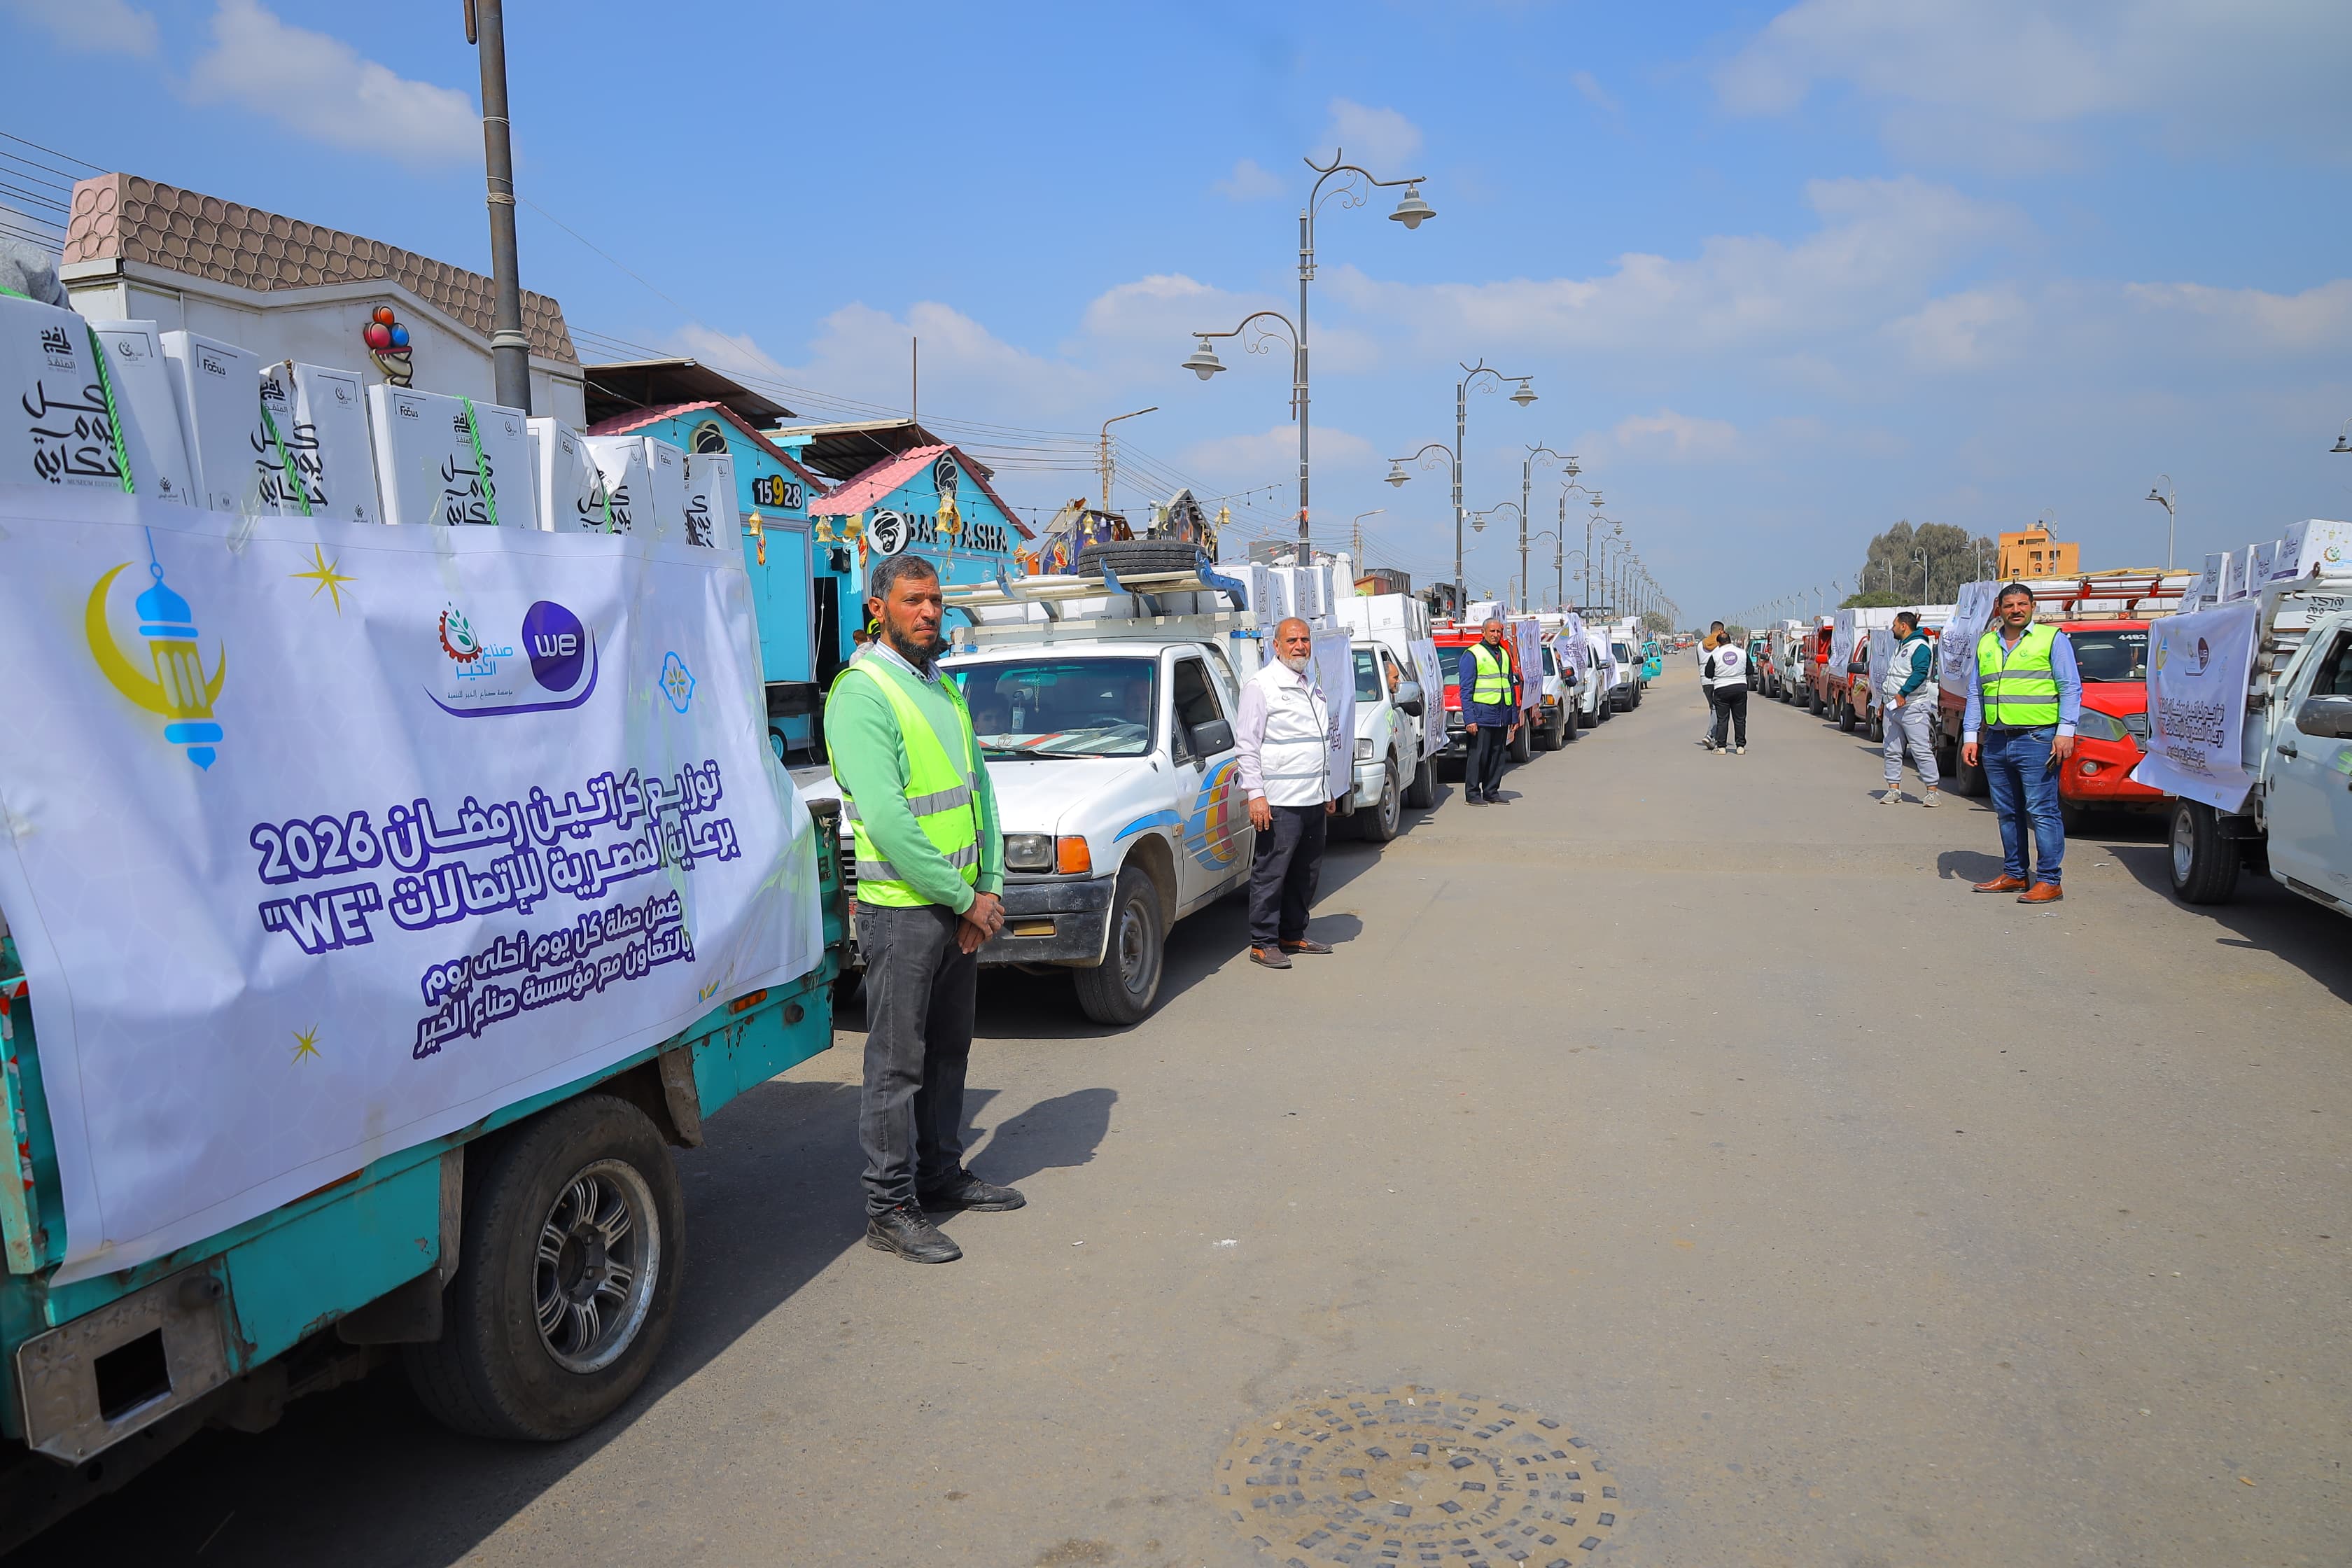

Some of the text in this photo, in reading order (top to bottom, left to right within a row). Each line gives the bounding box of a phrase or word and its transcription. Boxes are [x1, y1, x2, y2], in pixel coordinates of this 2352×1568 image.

[758, 476, 802, 508] 15928
[456, 660, 496, 681] الخير
[482, 643, 513, 666] صناع
[251, 760, 724, 885] توزيع كراتين رمضان 2026
[664, 815, 742, 869] برعاية
[550, 823, 665, 899] المصرية
[259, 883, 382, 955] "WE"
[573, 911, 606, 955] كل
[603, 904, 643, 939] حملة
[644, 890, 684, 932] ضمن
[530, 930, 573, 969] يوم
[597, 953, 624, 991] مع
[624, 926, 696, 979] بالتعاون
[422, 958, 473, 1007] يوم
[413, 997, 470, 1058] الخير
[470, 986, 519, 1038] صناع
